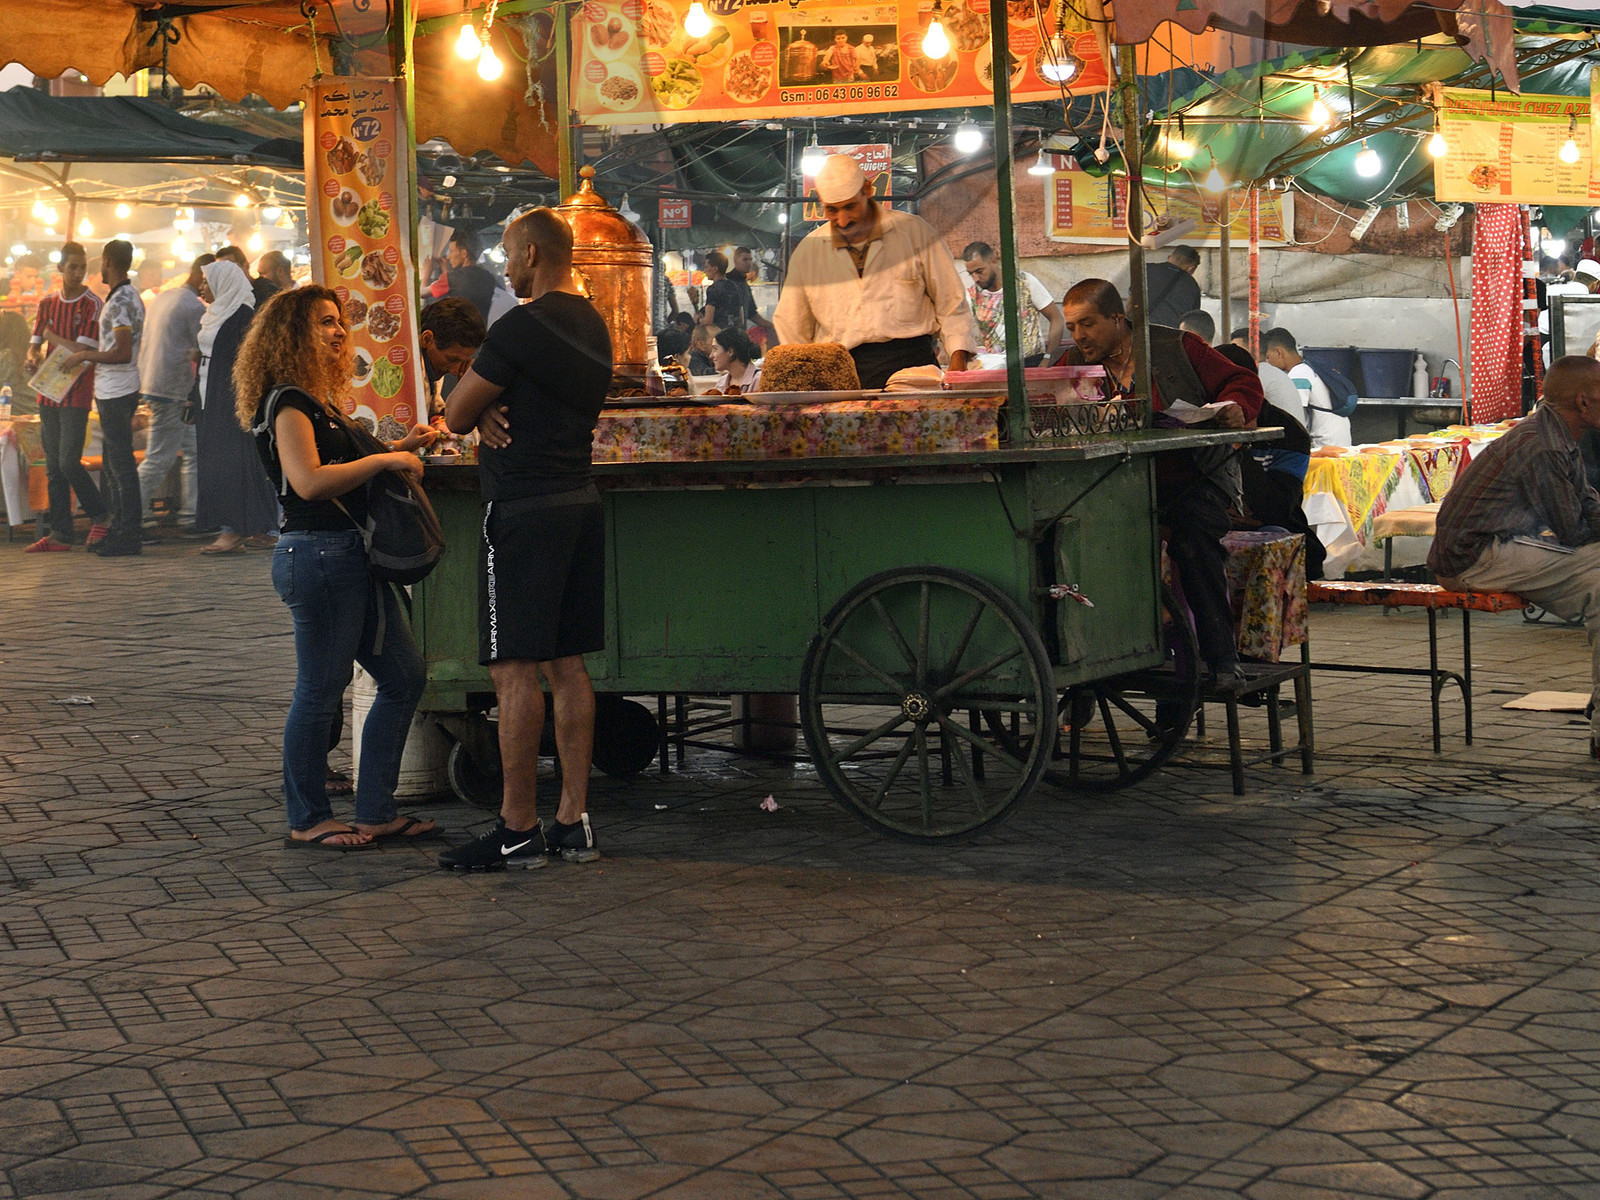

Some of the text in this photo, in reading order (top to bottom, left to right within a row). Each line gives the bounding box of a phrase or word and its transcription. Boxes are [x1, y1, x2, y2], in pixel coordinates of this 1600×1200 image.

[323, 88, 384, 104] مرحبا بكم
[781, 91, 805, 103] Gsm
[815, 88, 830, 101] 06
[832, 87, 847, 100] 43
[849, 86, 864, 99] 06
[866, 86, 881, 98] 96
[884, 85, 898, 98] 62
[320, 100, 391, 119] عند سي محمد
[1445, 98, 1522, 117] BIENVENUE
[1524, 101, 1560, 118] CHEZ
